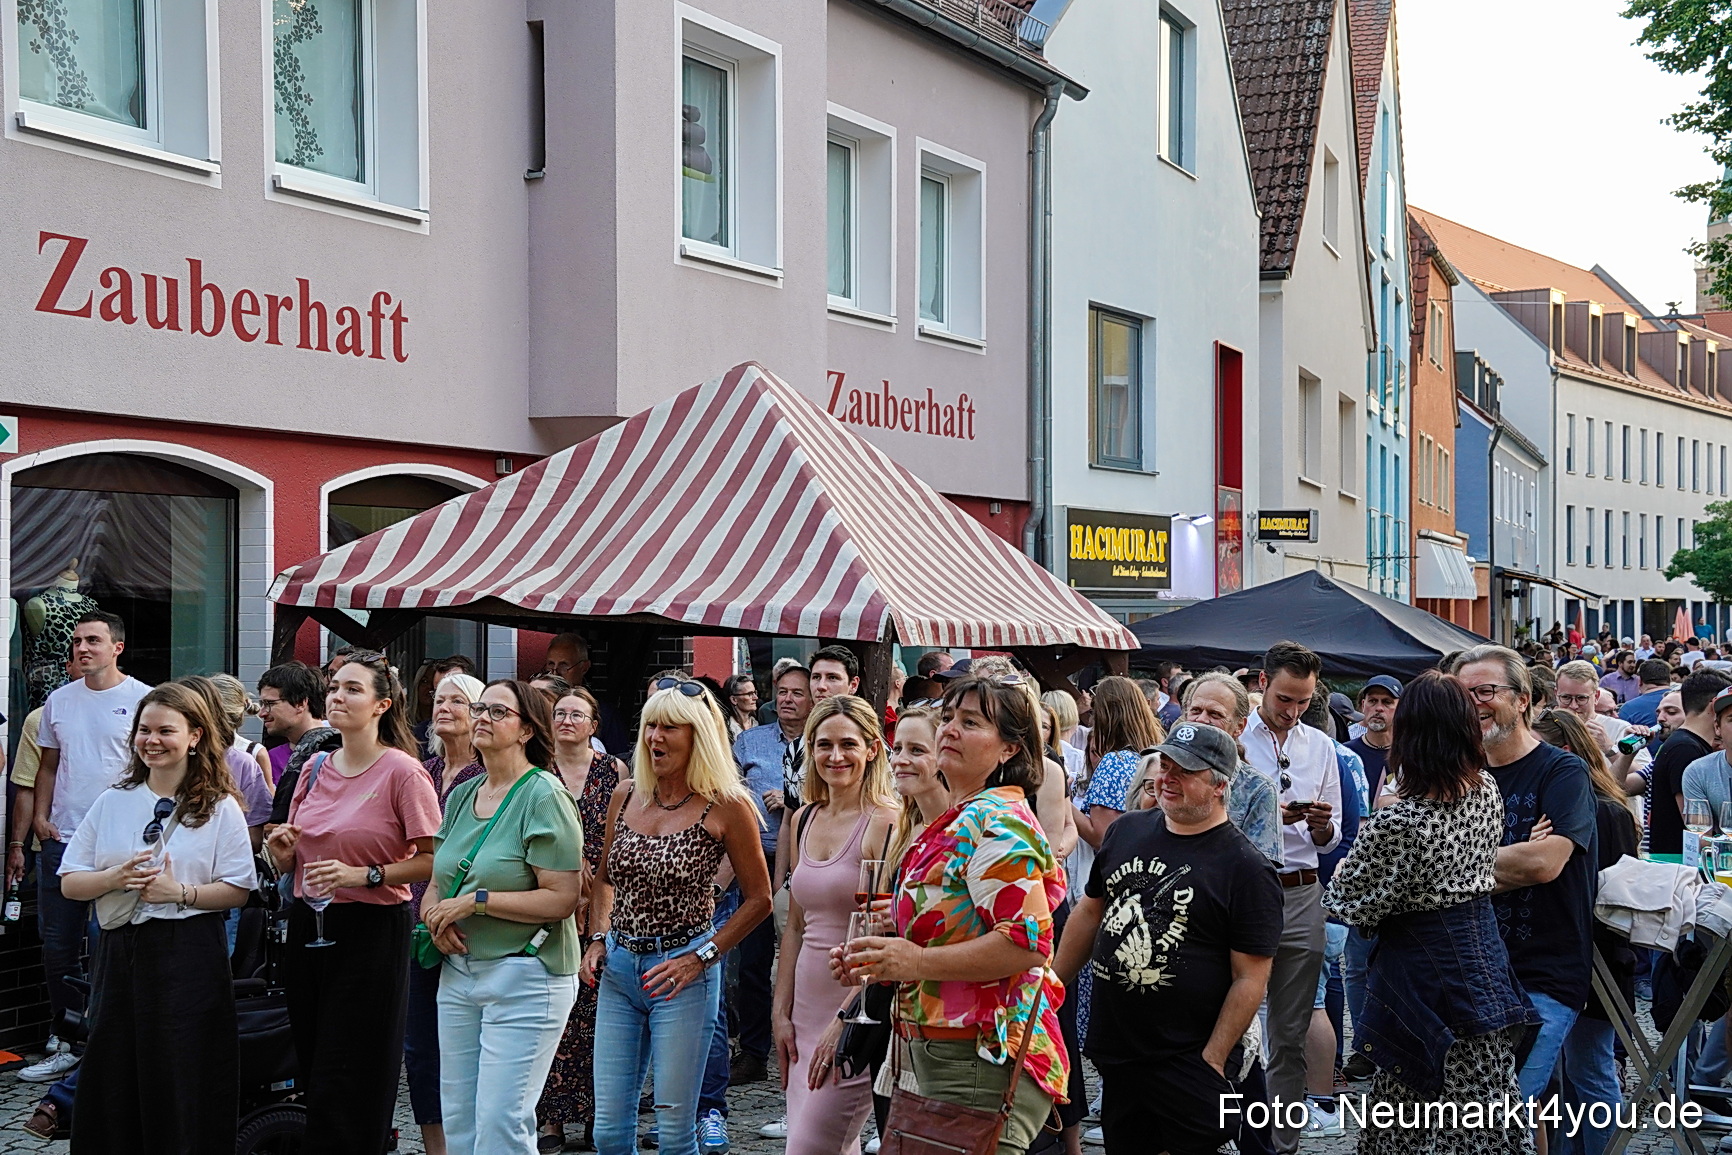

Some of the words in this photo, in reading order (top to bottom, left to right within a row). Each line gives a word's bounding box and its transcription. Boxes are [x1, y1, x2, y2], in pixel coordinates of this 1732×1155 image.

[35, 230, 409, 363] Zauberhaft
[826, 370, 976, 441] Zauberhaft
[1069, 523, 1168, 563] HACIMURAT
[1260, 517, 1309, 531] HACIMURAT
[1148, 856, 1168, 876] in
